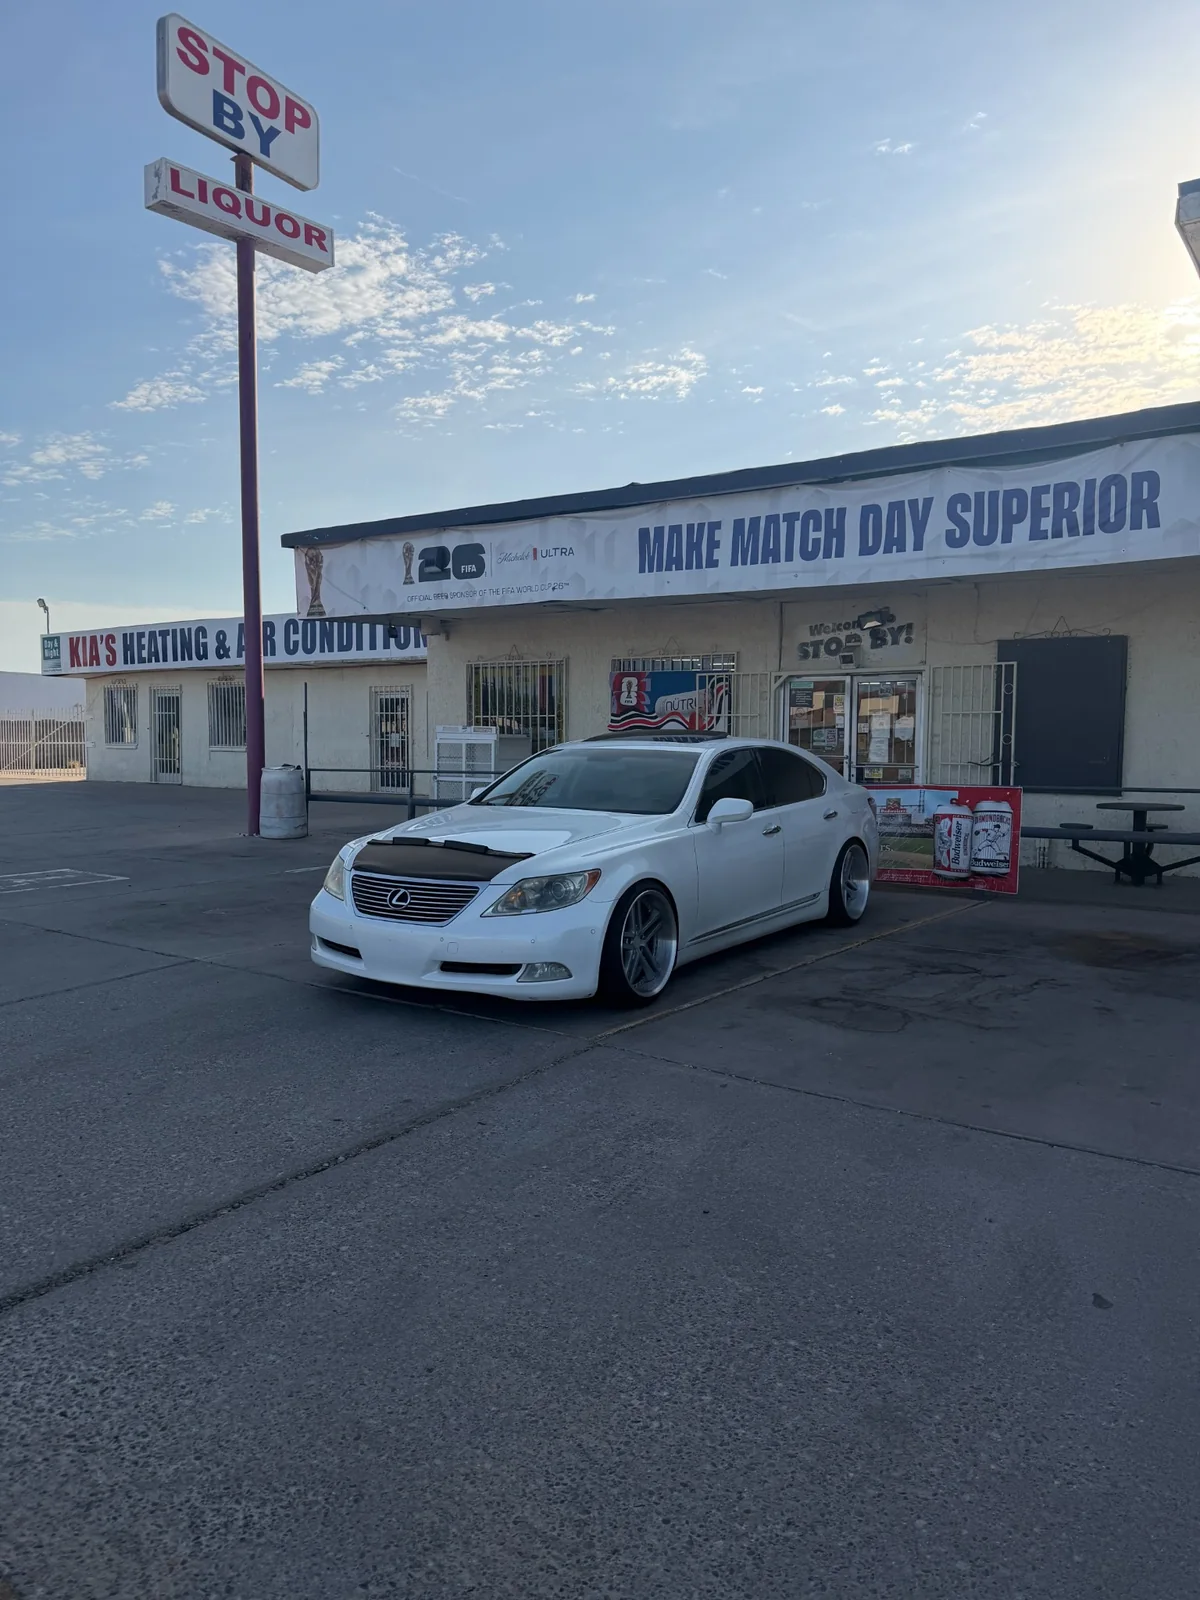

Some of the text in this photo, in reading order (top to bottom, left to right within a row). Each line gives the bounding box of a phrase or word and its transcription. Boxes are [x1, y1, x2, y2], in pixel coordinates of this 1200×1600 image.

[176, 27, 311, 134] STOP
[212, 88, 282, 158] BY
[170, 168, 328, 252] LIQUOR
[638, 470, 1161, 574] MAKE MATCH DAY SUPERIOR
[461, 564, 477, 574] FIFA
[540, 546, 575, 559] ULTRA
[407, 594, 432, 603] OFFICIAL
[433, 592, 449, 601] BEER
[450, 590, 478, 600] SPONSOR
[478, 589, 488, 598] OF
[489, 588, 501, 596] THE
[501, 587, 515, 596] FIFA
[516, 584, 540, 594] WORLD
[540, 583, 553, 592] CUP
[44, 638, 59, 649] Day &
[44, 648, 60, 659] Night
[69, 634, 117, 668] KIA'S
[122, 625, 208, 665] HEATING
[215, 629, 231, 660] &
[236, 620, 276, 658] AR
[869, 622, 915, 650] BY!
[951, 820, 963, 866] Budweiser
